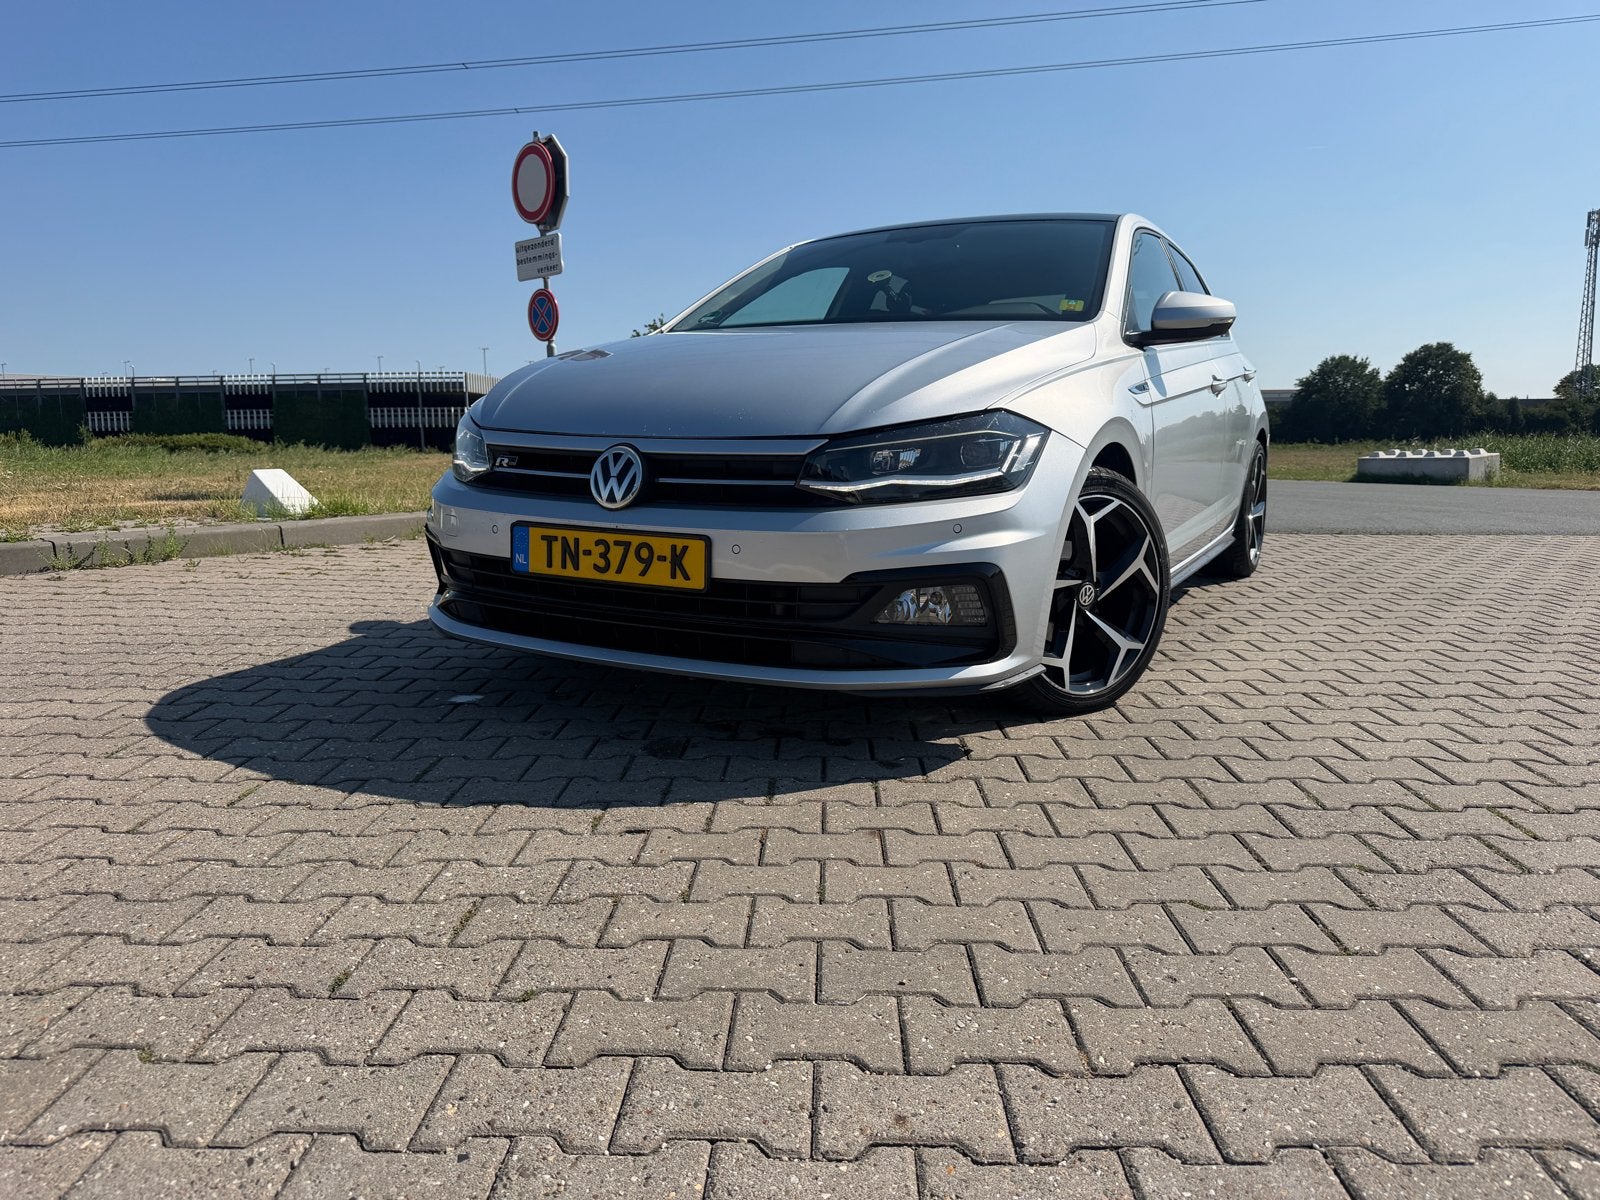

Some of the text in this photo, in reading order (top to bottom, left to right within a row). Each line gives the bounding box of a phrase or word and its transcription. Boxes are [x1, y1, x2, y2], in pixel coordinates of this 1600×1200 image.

[537, 264, 558, 273] verkeer
[590, 446, 642, 509] VW
[515, 553, 527, 564] NL
[540, 534, 691, 582] TN-379-K
